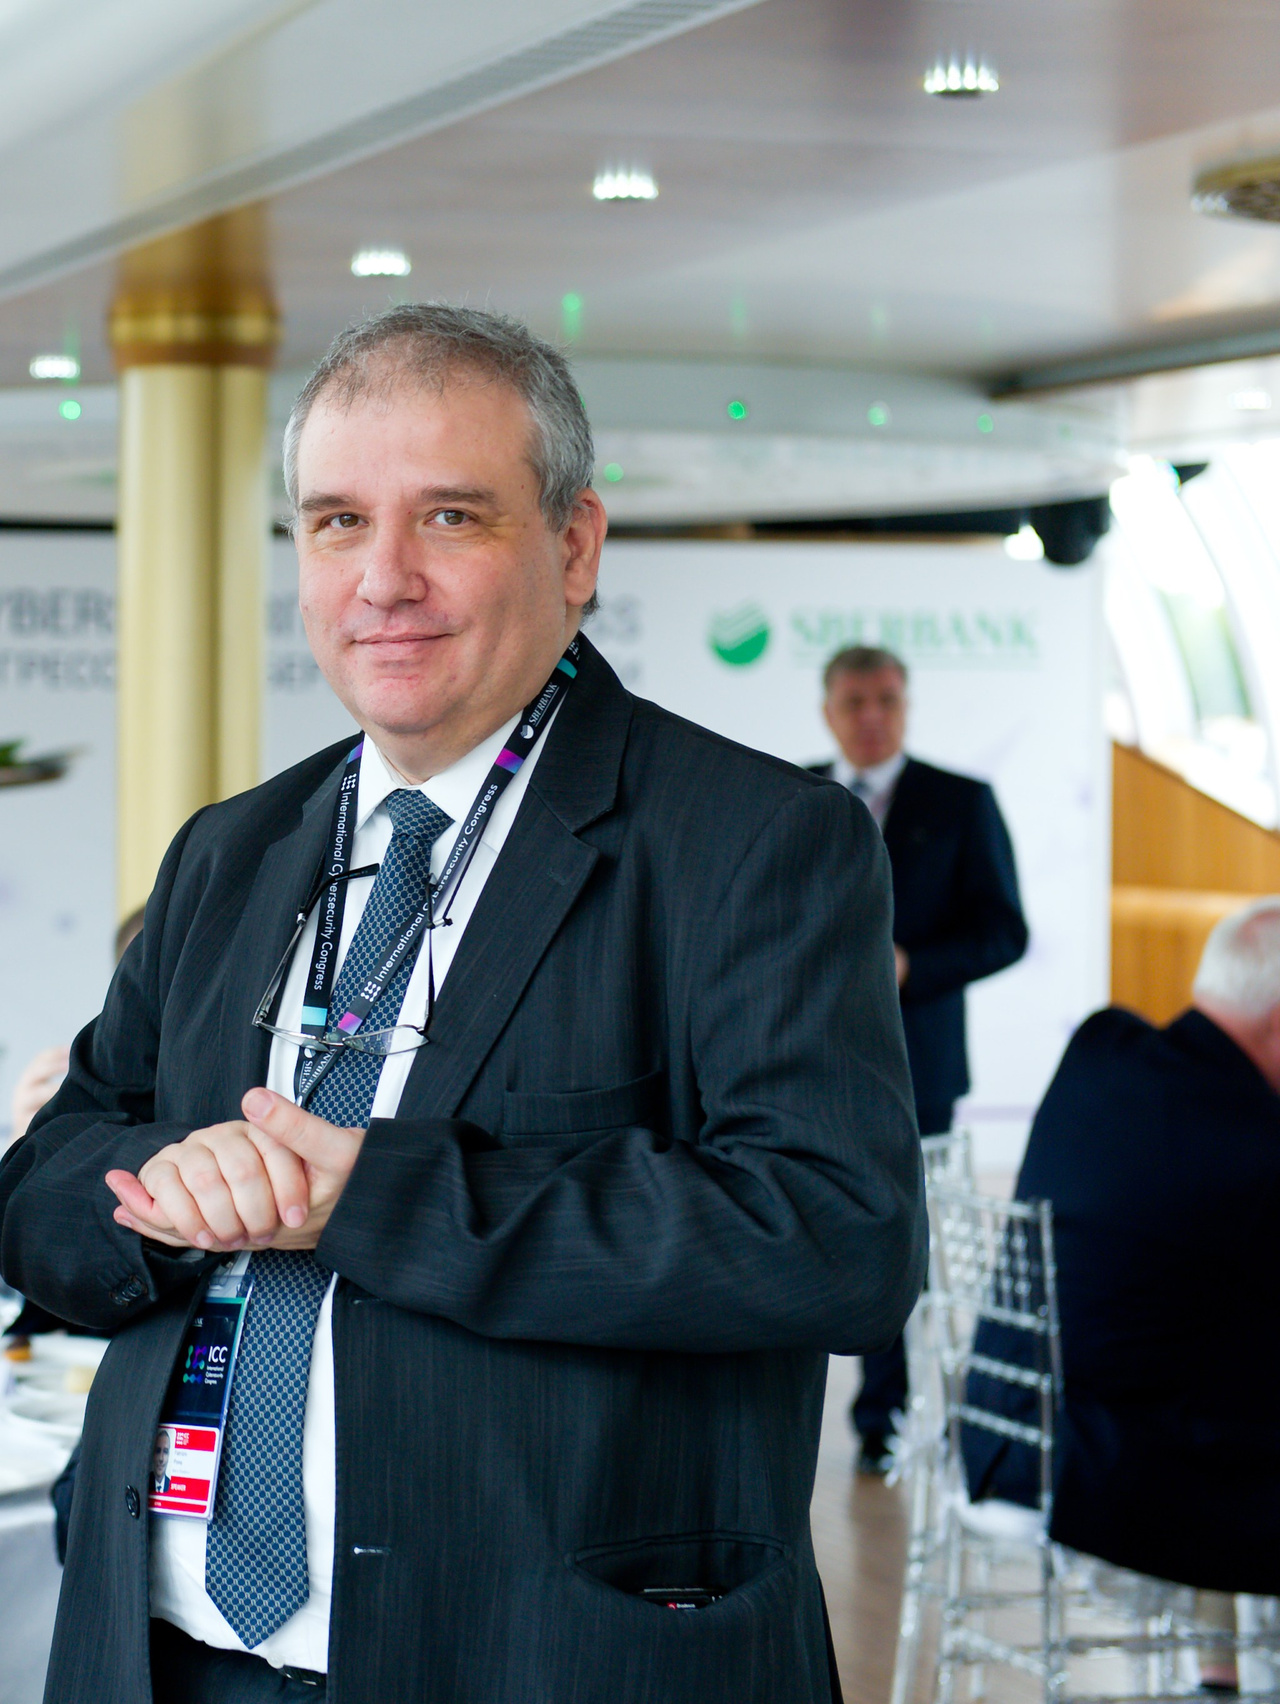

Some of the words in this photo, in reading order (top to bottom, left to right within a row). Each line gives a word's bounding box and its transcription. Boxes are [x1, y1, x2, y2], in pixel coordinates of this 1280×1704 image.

[529, 683, 558, 726] SBERBANK
[332, 791, 352, 862] International
[320, 863, 344, 940] Cyersecurity
[375, 912, 425, 982] International
[422, 836, 469, 913] Cbersecurity
[464, 783, 498, 835] Congress
[314, 941, 333, 991] Congress
[207, 1345, 228, 1363] ICC
